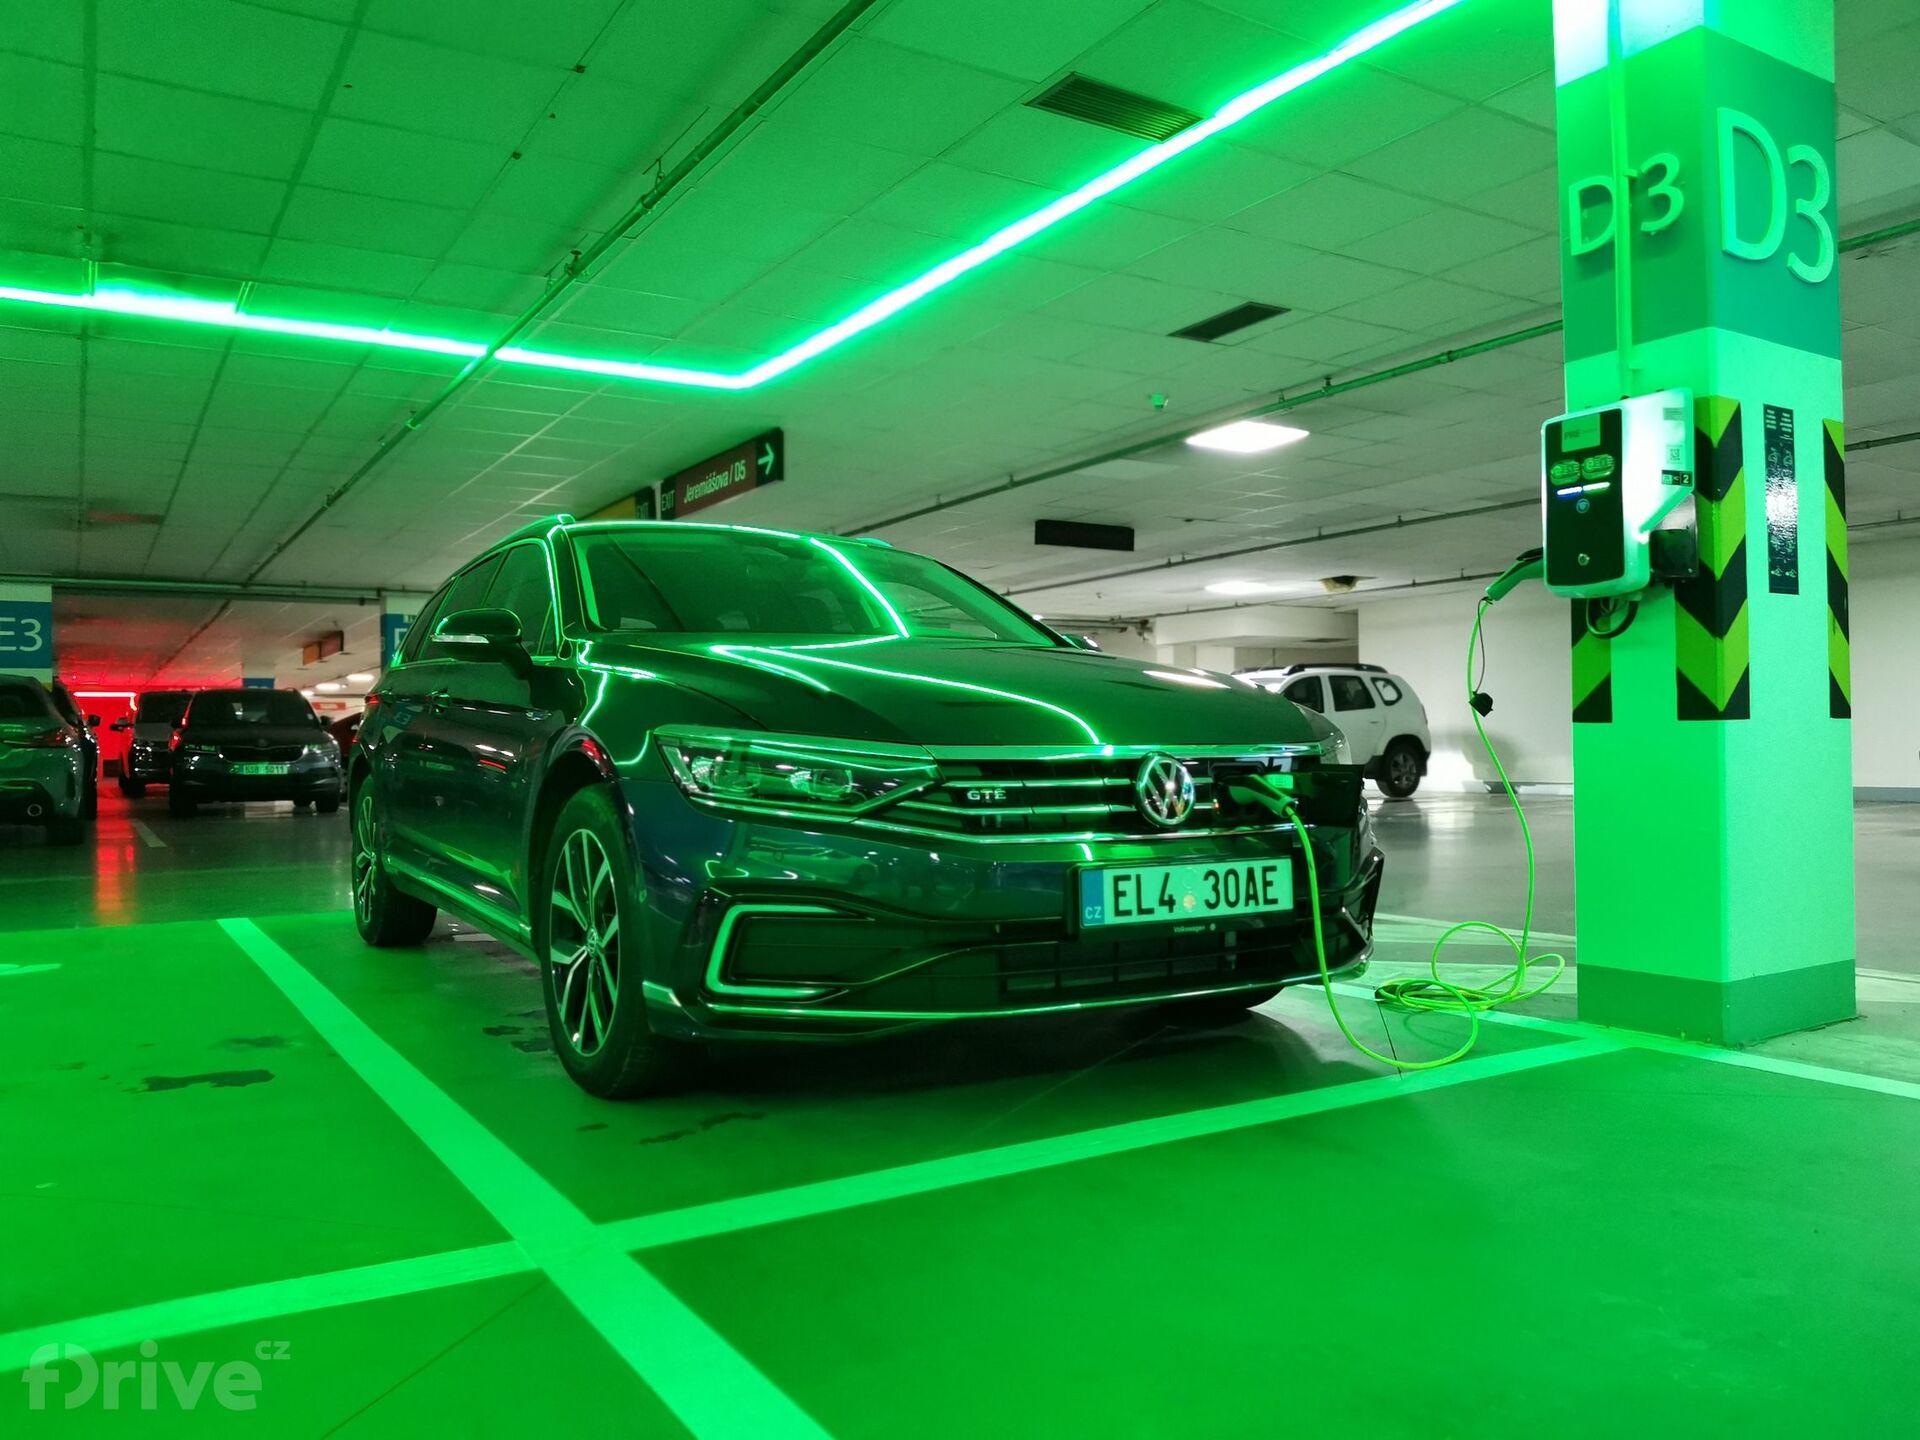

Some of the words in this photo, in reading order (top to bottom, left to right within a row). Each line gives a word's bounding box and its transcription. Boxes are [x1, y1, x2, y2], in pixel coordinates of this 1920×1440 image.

[1568, 153, 1684, 256] D3
[1717, 107, 1834, 283] D3
[661, 490, 675, 511] EXIT
[0, 617, 43, 652] E3
[967, 789, 1006, 800] GTE
[1112, 872, 1176, 917] EL4
[1203, 865, 1279, 910] 30AE
[1084, 906, 1102, 920] CZ
